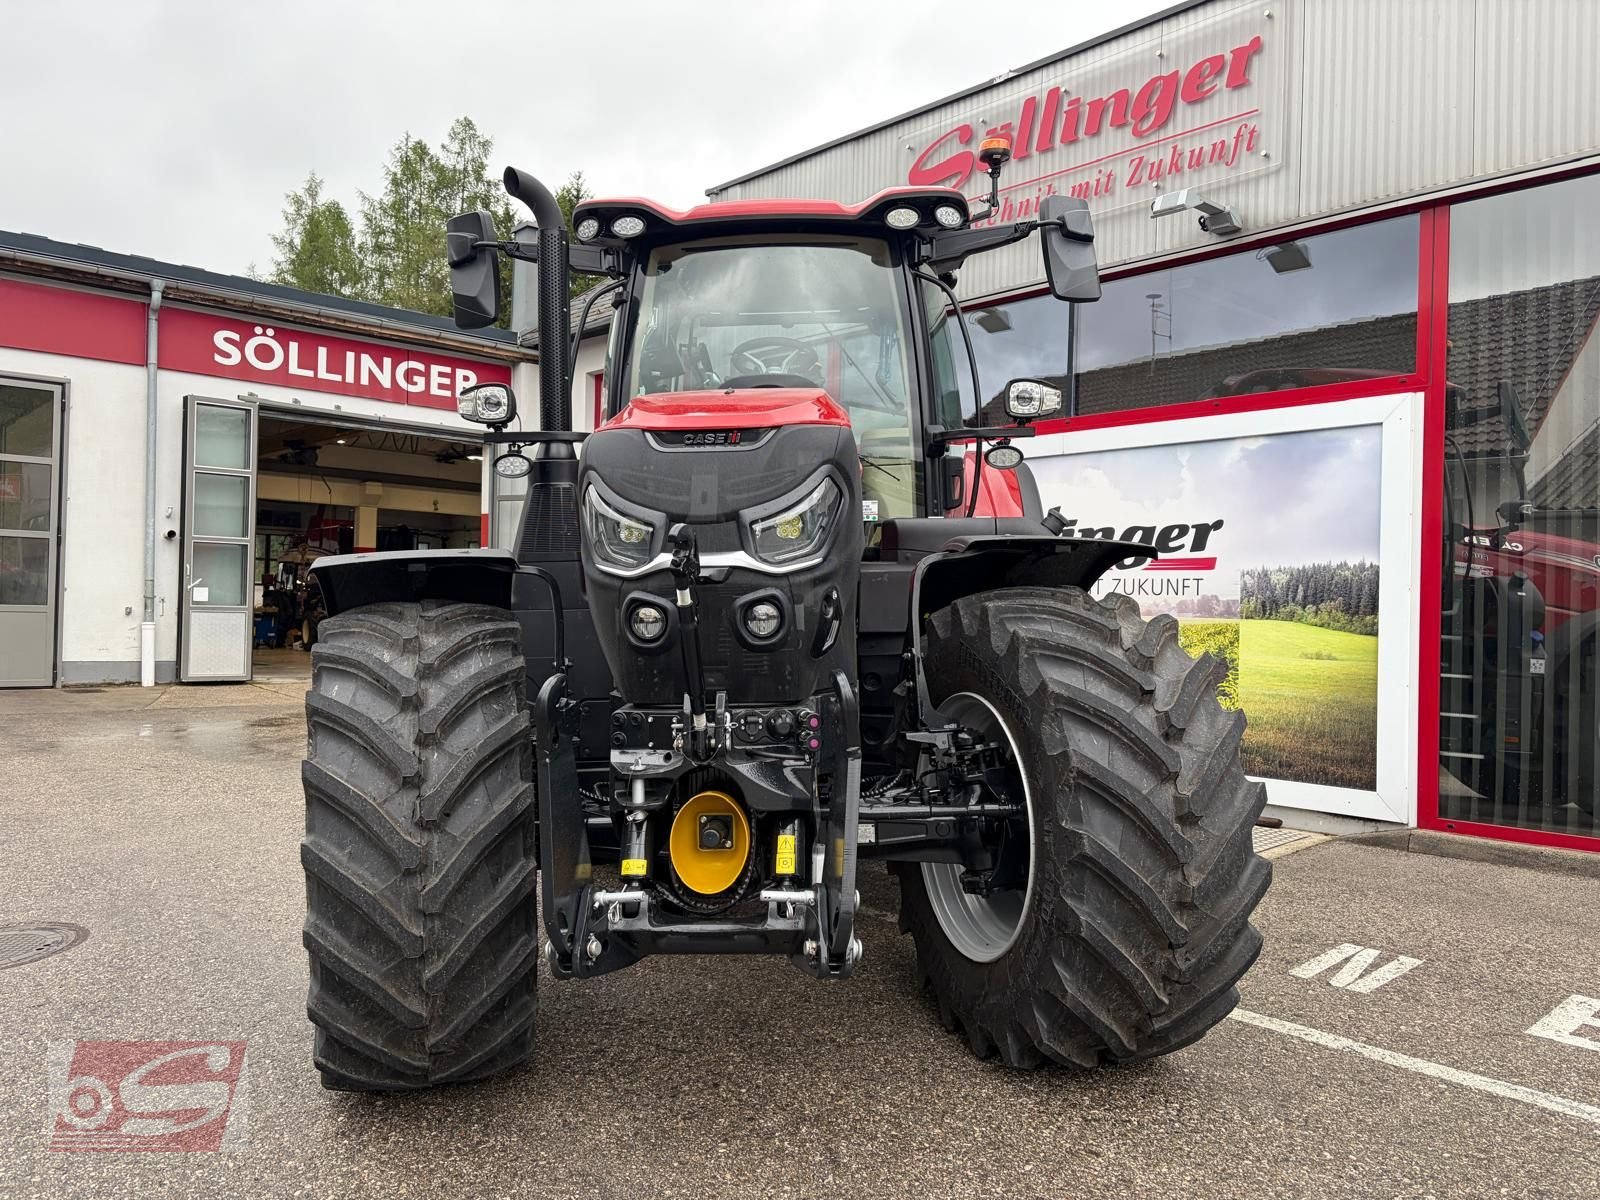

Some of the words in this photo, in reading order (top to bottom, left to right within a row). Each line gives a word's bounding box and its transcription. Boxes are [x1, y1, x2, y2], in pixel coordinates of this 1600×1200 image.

[1070, 169, 1114, 199] mit
[1125, 123, 1259, 188] Zukunft
[213, 326, 478, 398] SÖLLINGER
[683, 433, 726, 444] CASE
[1112, 578, 1204, 596] ZUKUNFT
